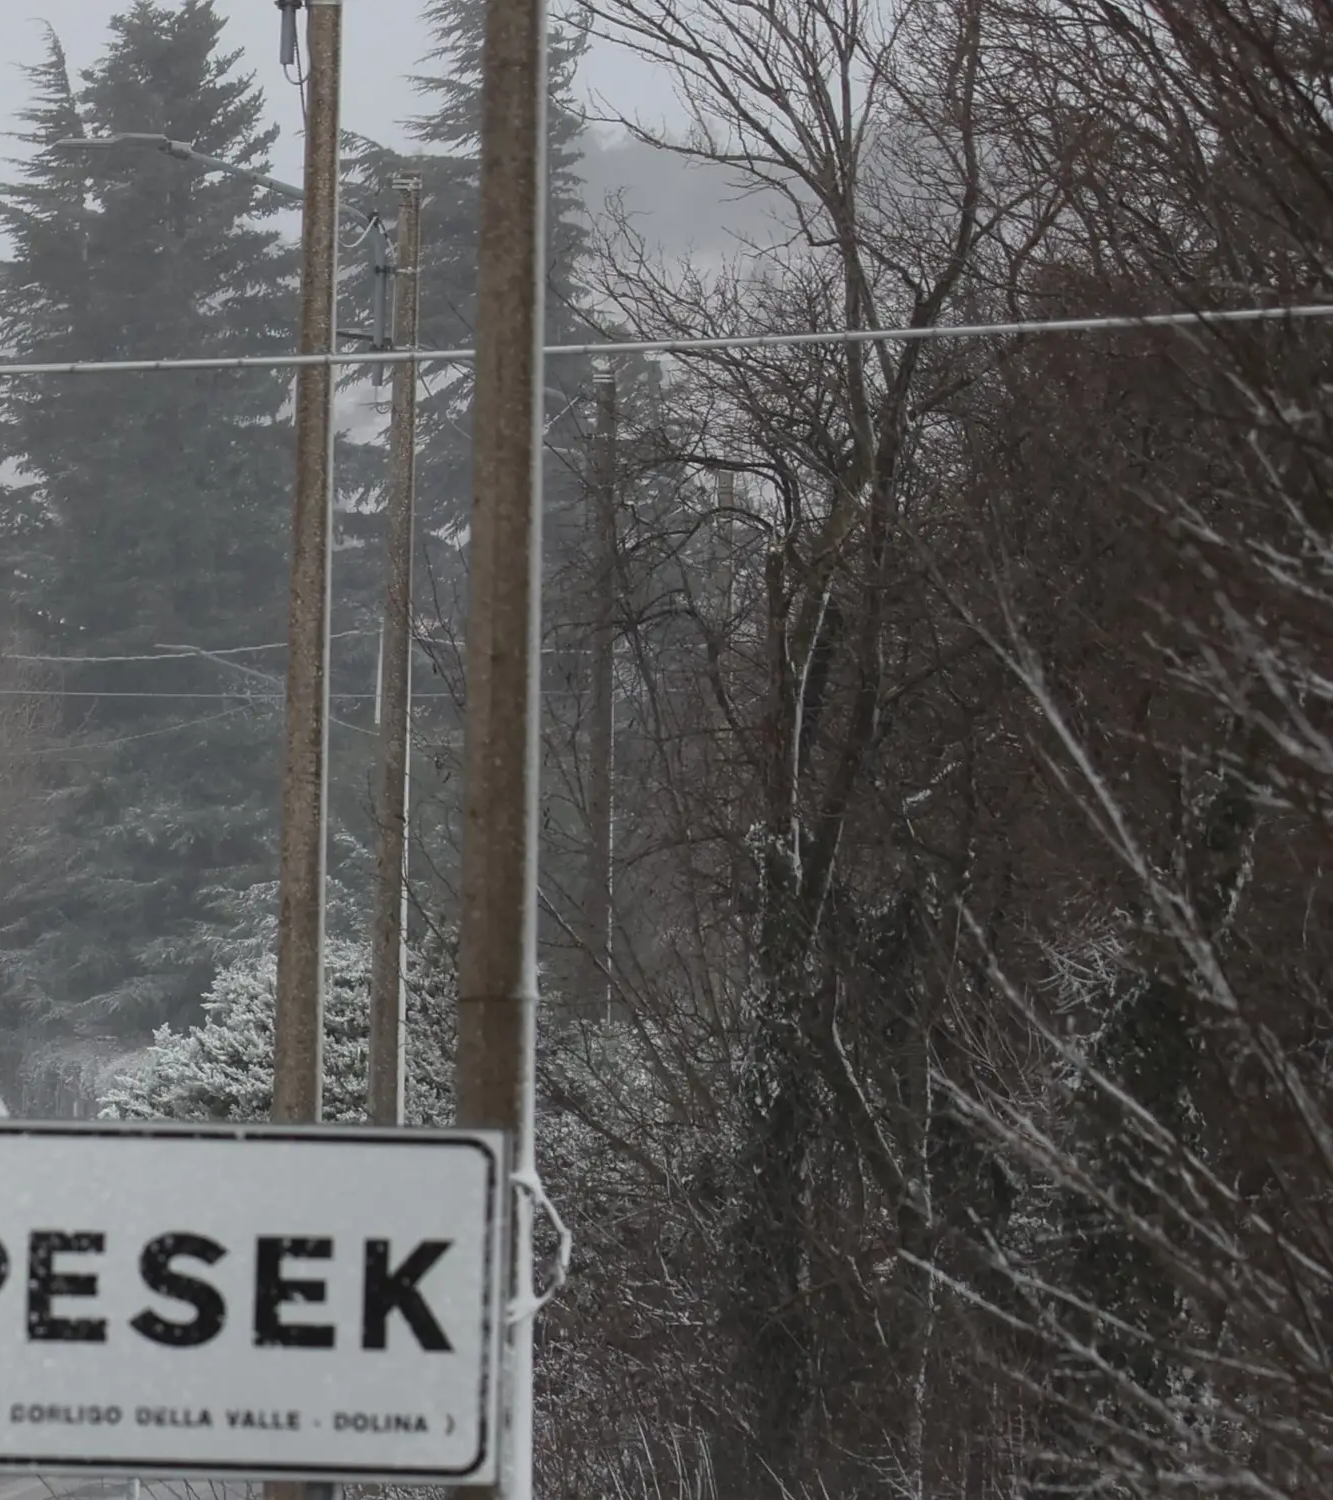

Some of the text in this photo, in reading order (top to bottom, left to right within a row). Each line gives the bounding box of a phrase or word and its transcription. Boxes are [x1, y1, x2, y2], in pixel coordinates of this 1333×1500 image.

[136, 1405, 213, 1428] DELLA
[226, 1408, 301, 1431] VALLE
[333, 1411, 430, 1434] DOLINA
